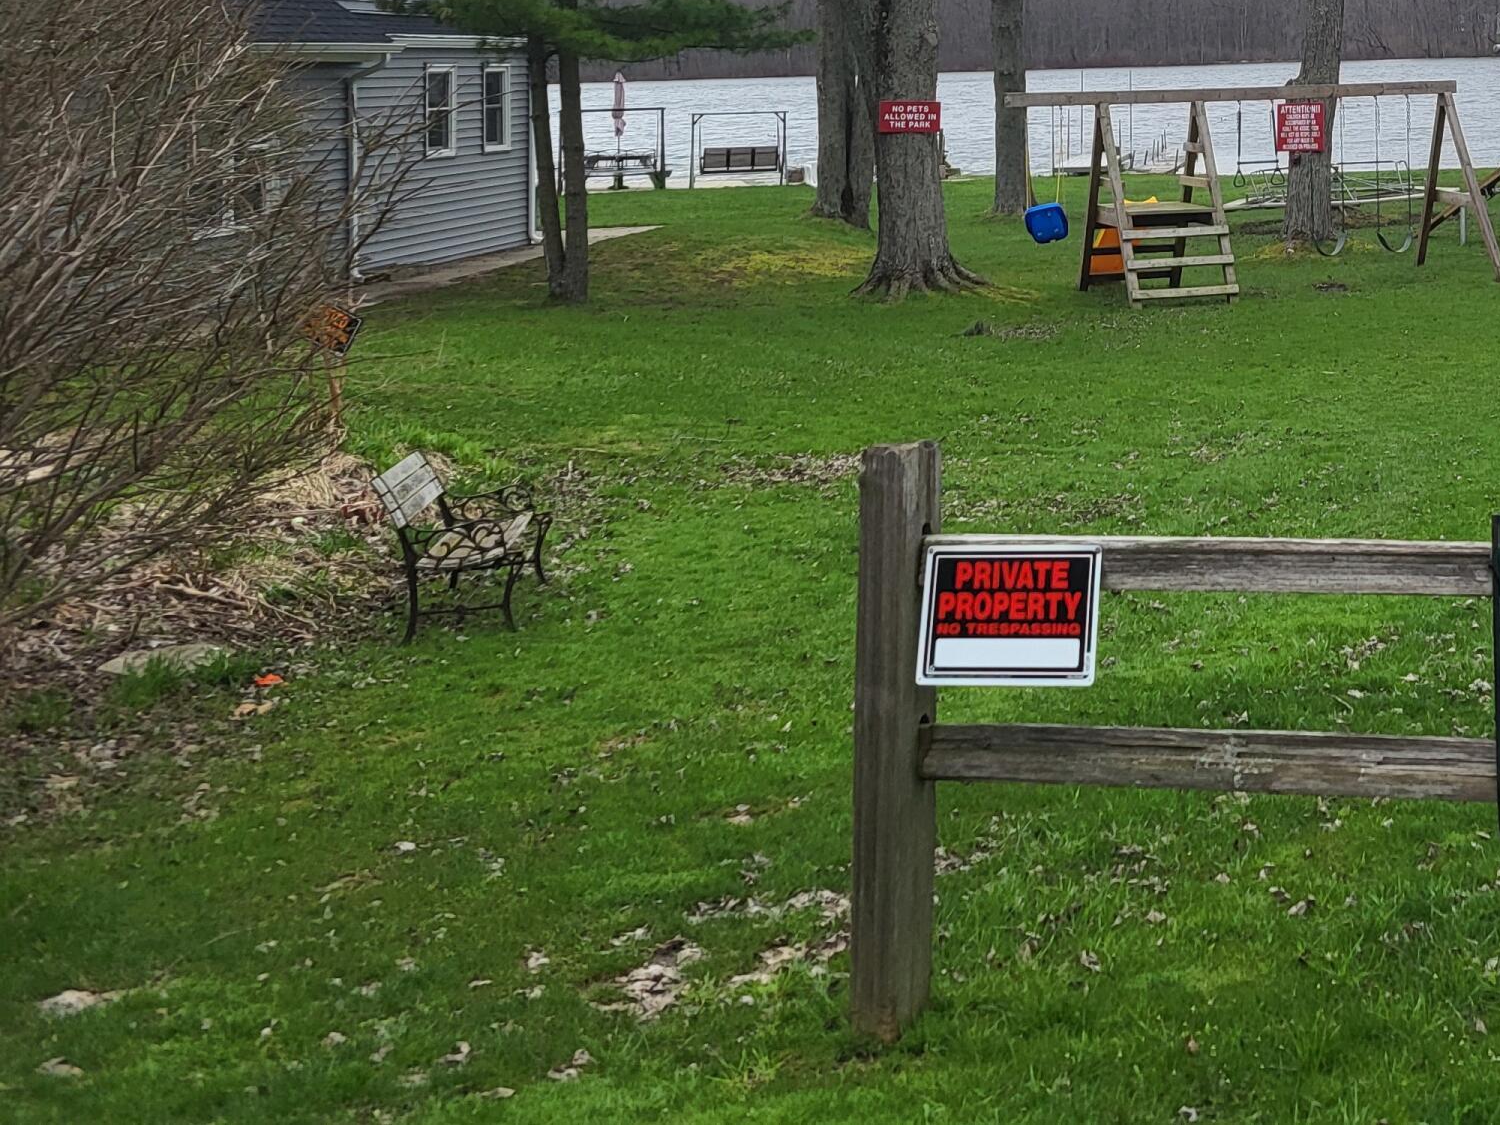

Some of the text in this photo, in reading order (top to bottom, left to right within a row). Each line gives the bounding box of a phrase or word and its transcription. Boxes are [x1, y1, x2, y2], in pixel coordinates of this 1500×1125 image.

[954, 561, 1071, 590] PRIVATE
[937, 591, 1083, 621] PROPERTY
[936, 622, 1082, 636] NO TRESPASSING
